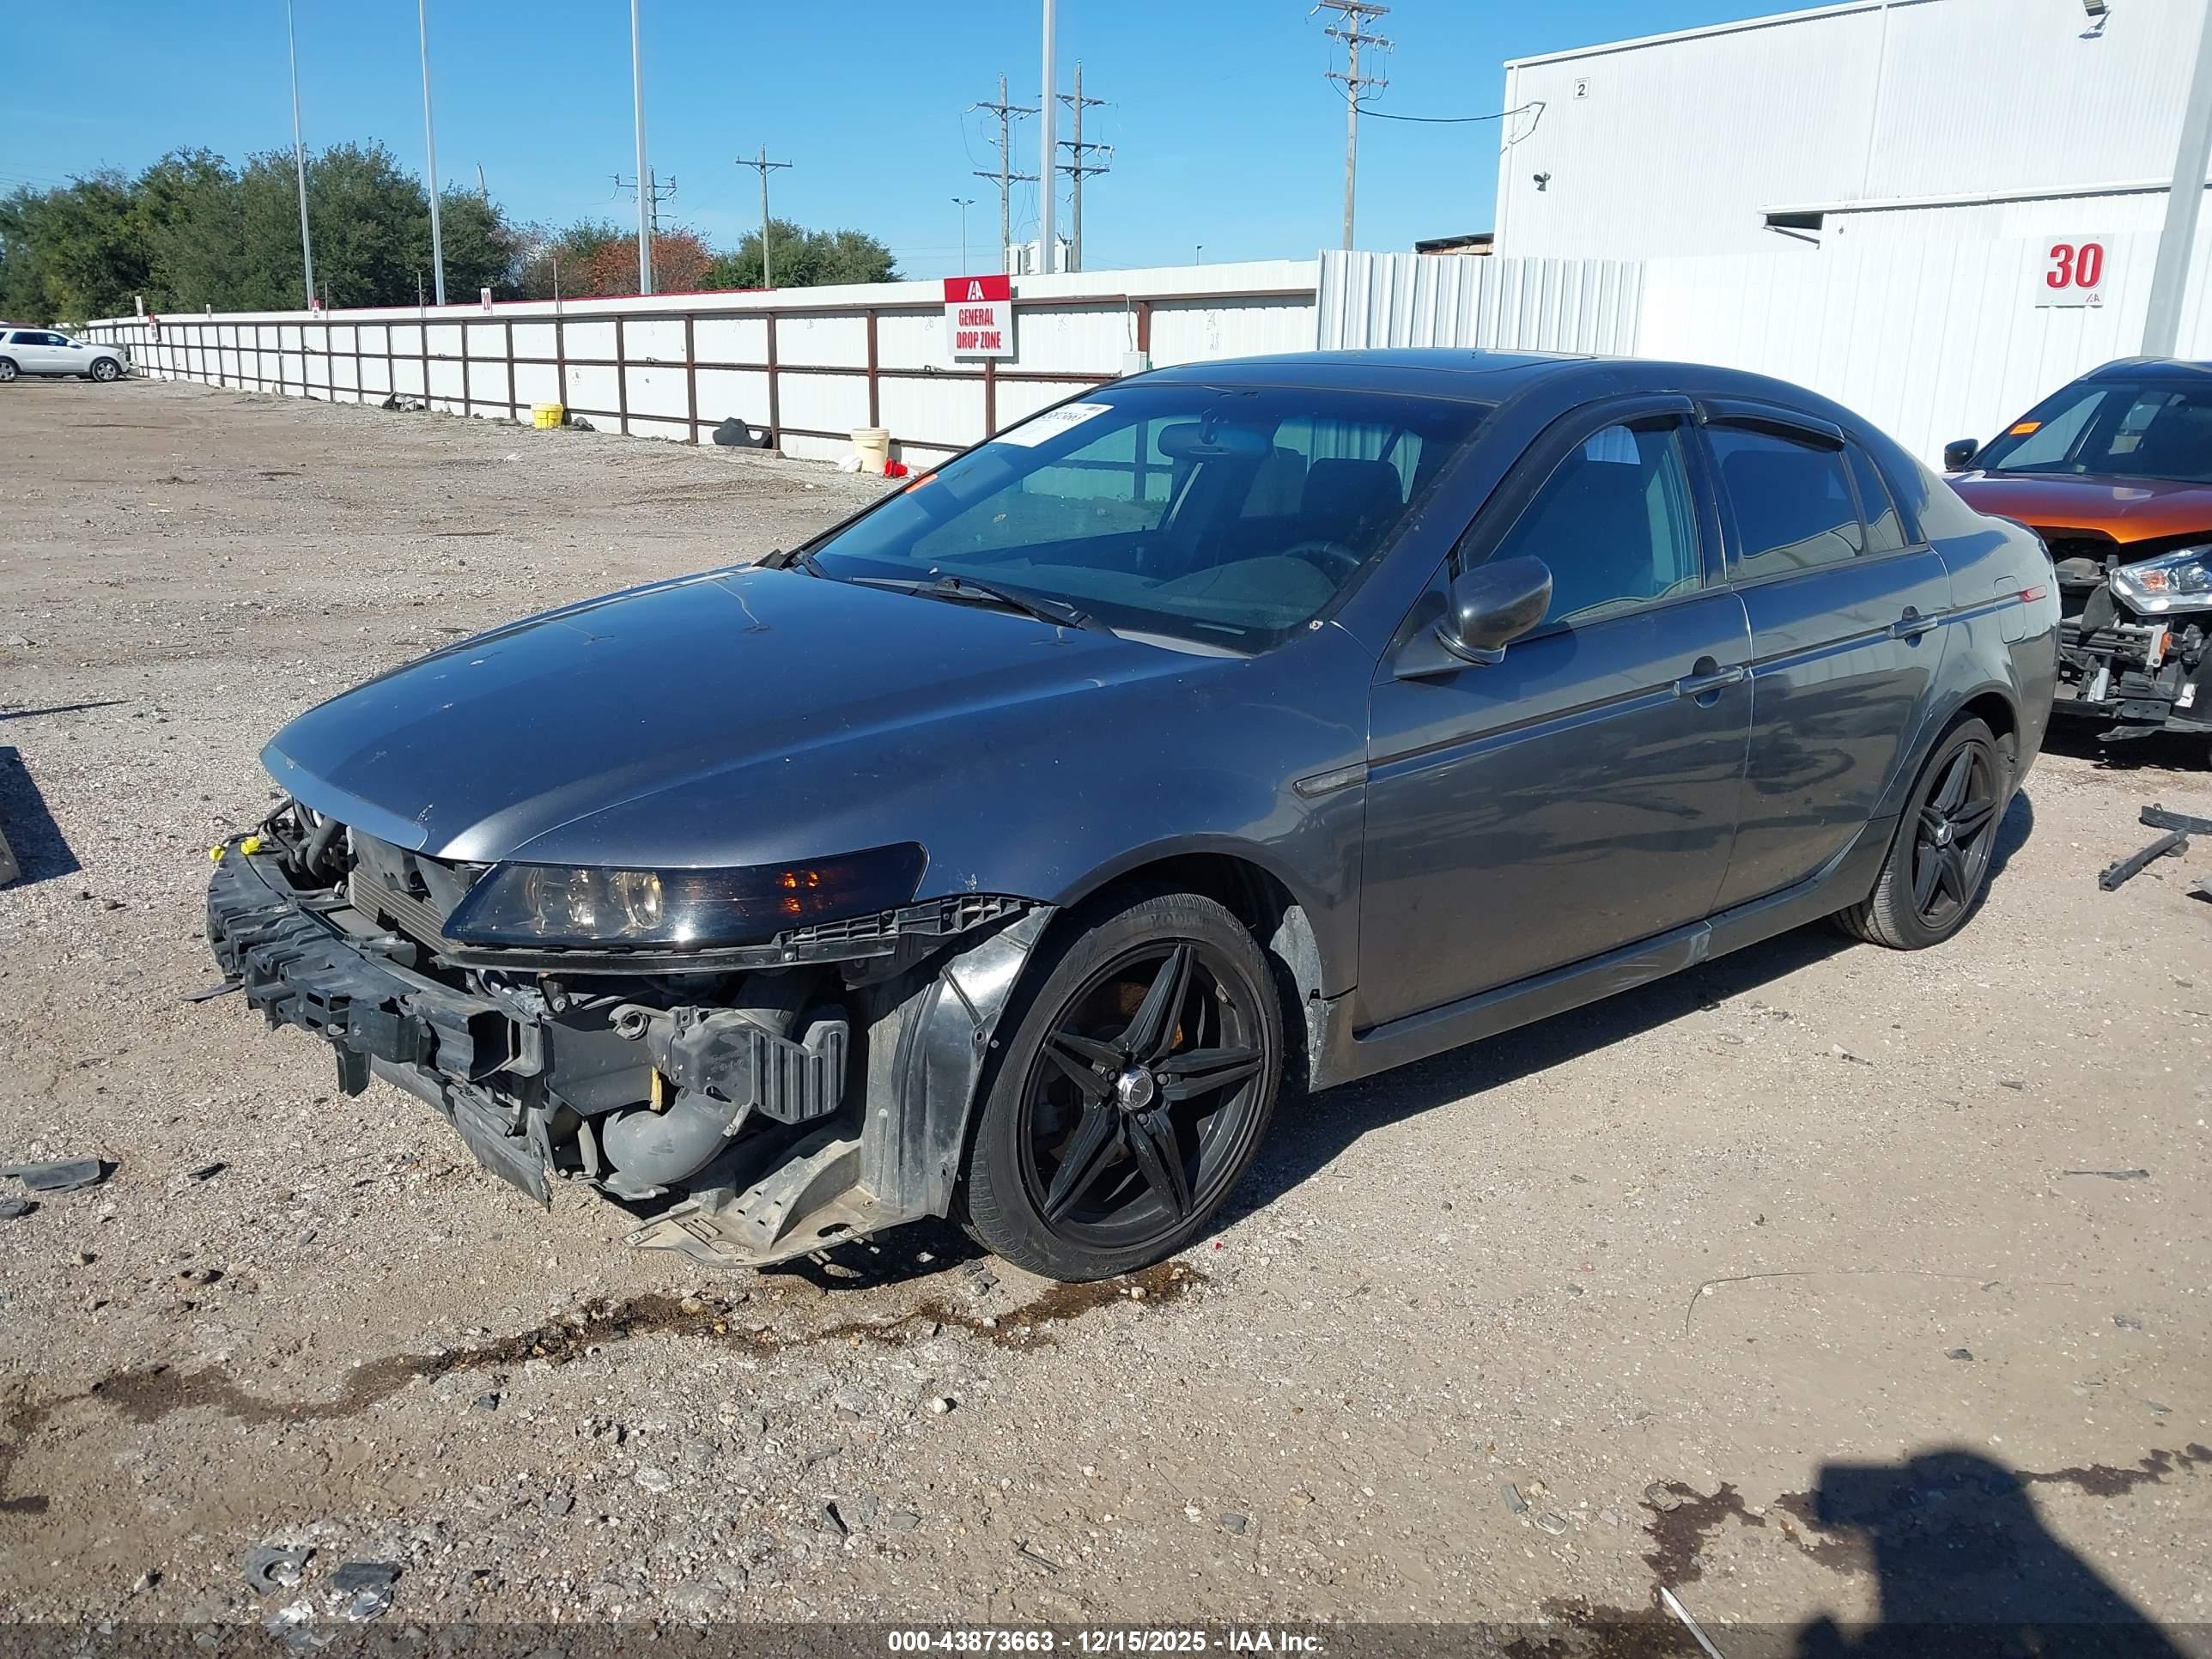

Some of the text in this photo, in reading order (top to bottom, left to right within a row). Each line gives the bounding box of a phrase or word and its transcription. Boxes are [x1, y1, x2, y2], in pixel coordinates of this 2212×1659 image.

[1577, 84, 1585, 96] 2
[2047, 243, 2104, 289] 30
[959, 308, 994, 326] GENERAL
[957, 331, 1001, 349] DROP ZONE
